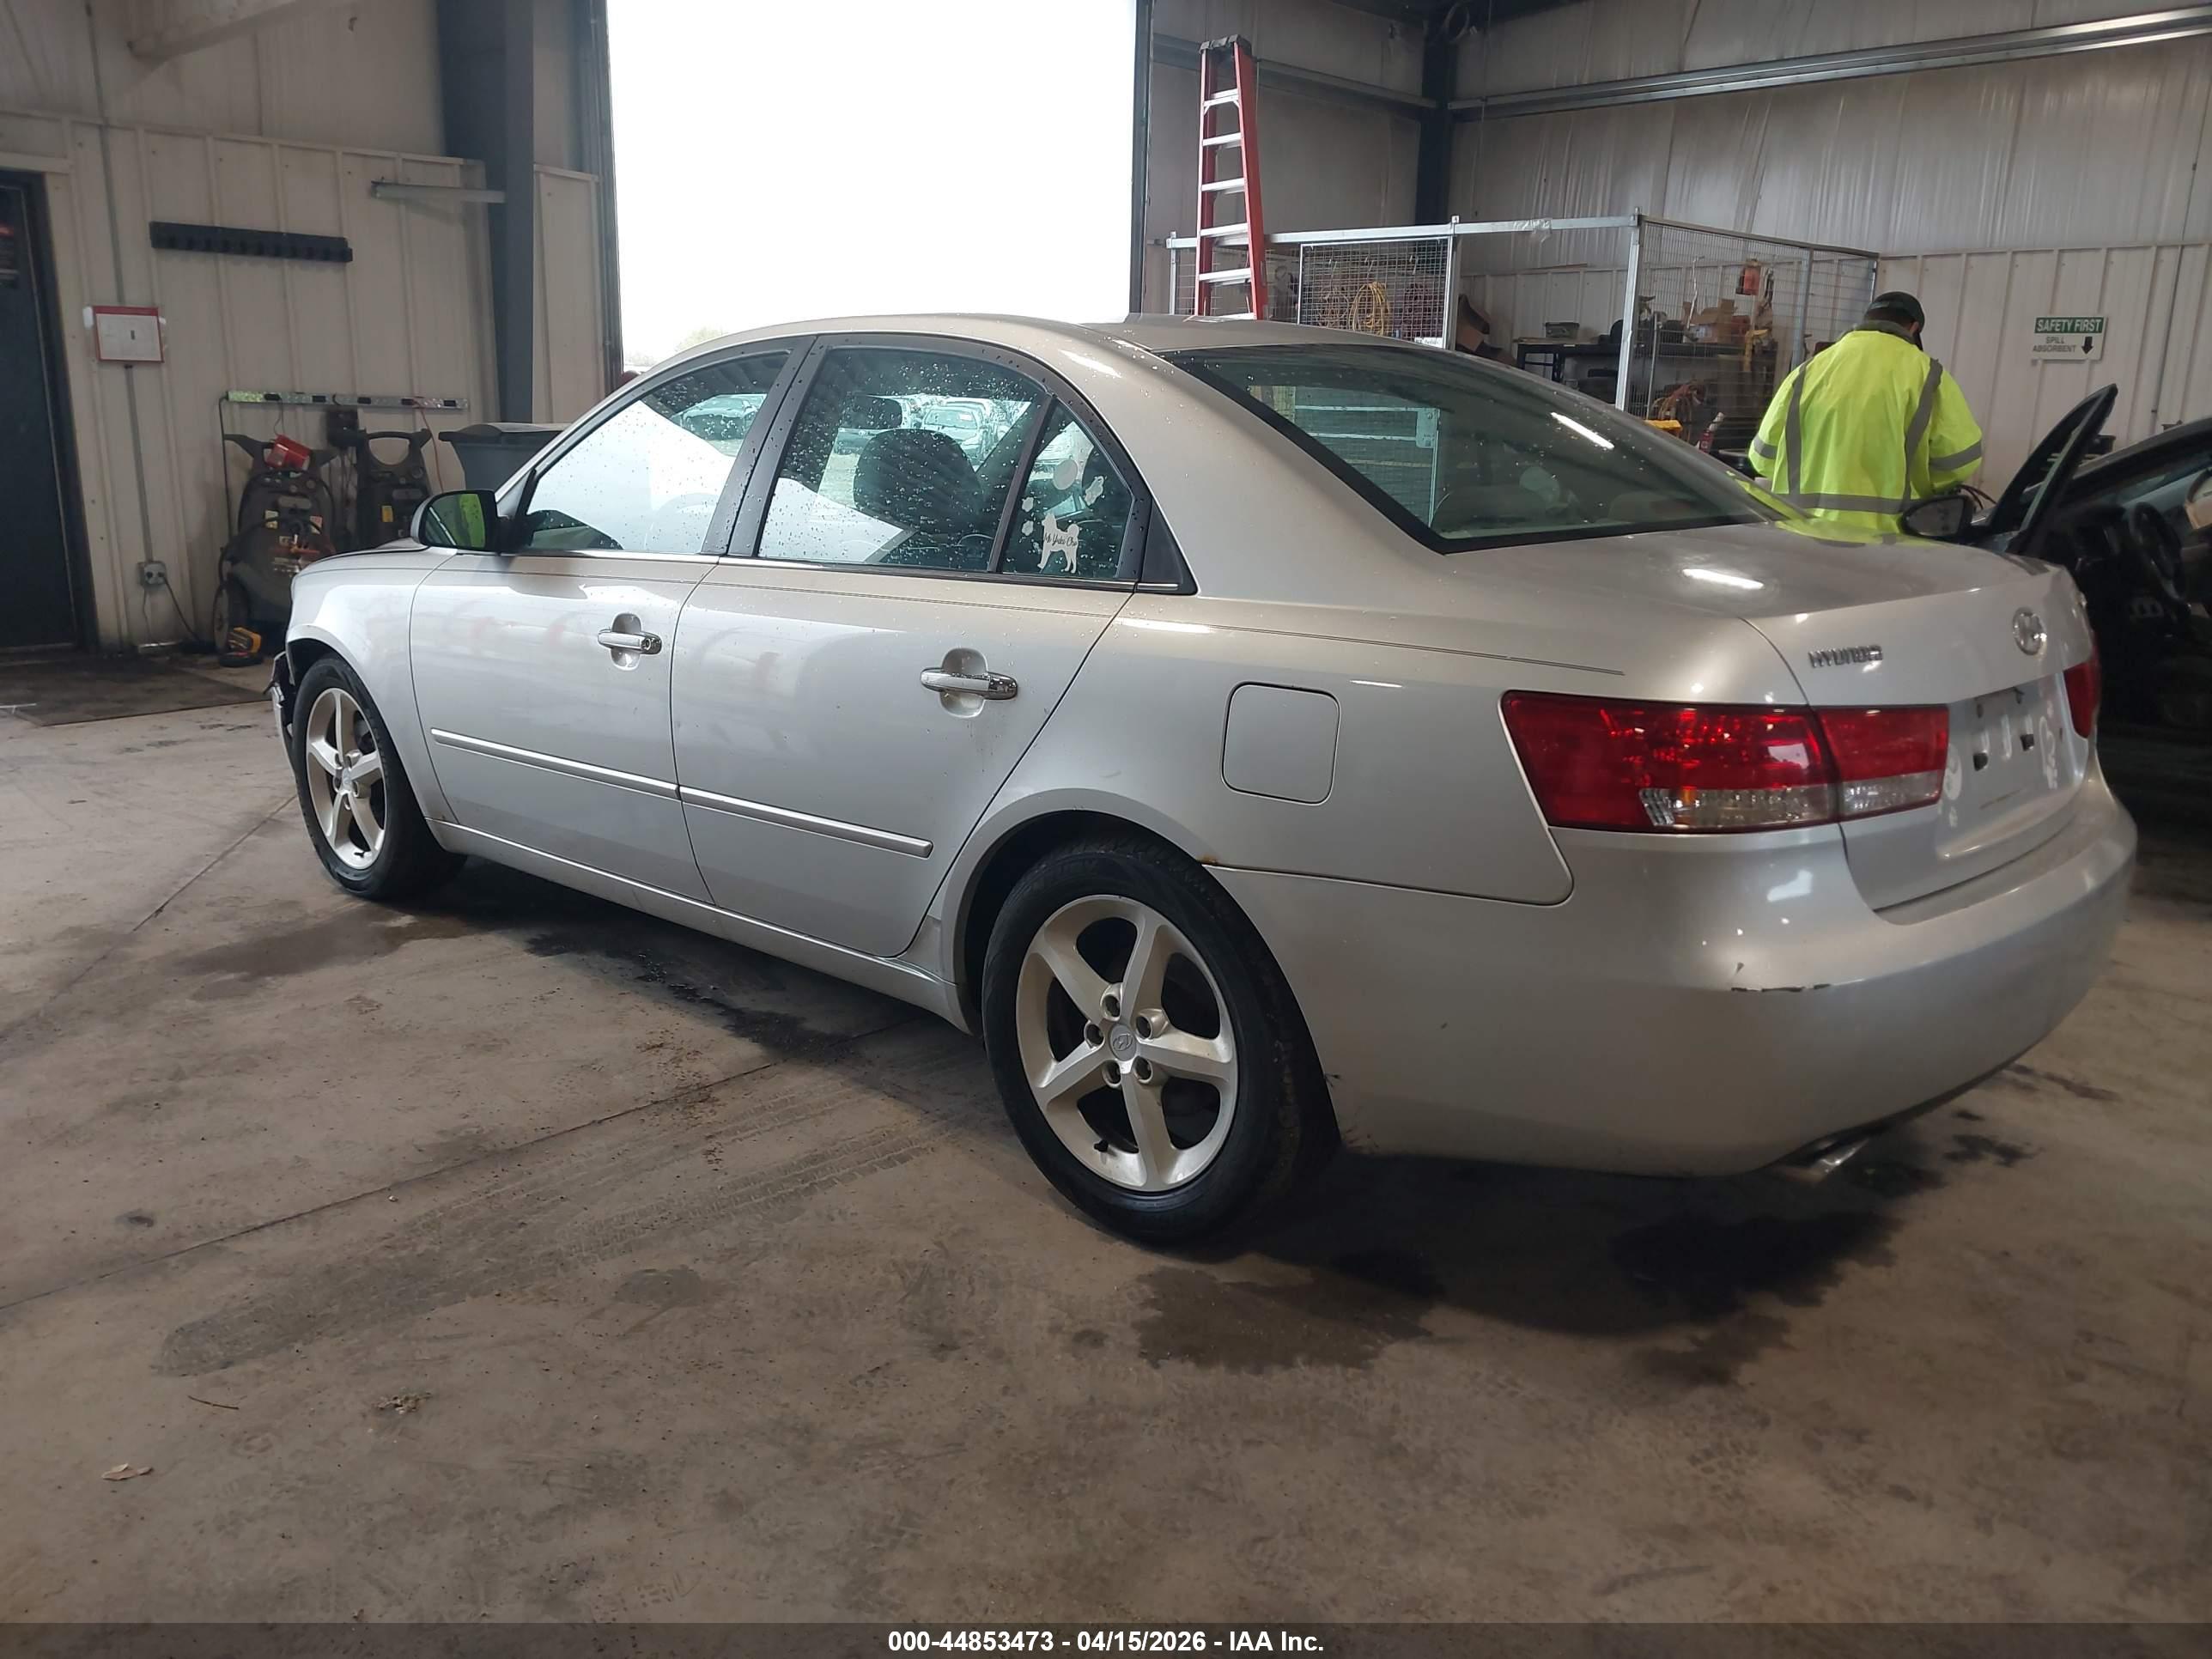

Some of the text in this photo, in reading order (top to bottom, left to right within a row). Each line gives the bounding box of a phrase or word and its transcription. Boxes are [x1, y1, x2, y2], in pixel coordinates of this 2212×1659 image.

[2037, 319, 2102, 332] SAFETY FIRST
[2045, 336, 2065, 344] SPILL
[2033, 344, 2076, 353] ABSORBENT
